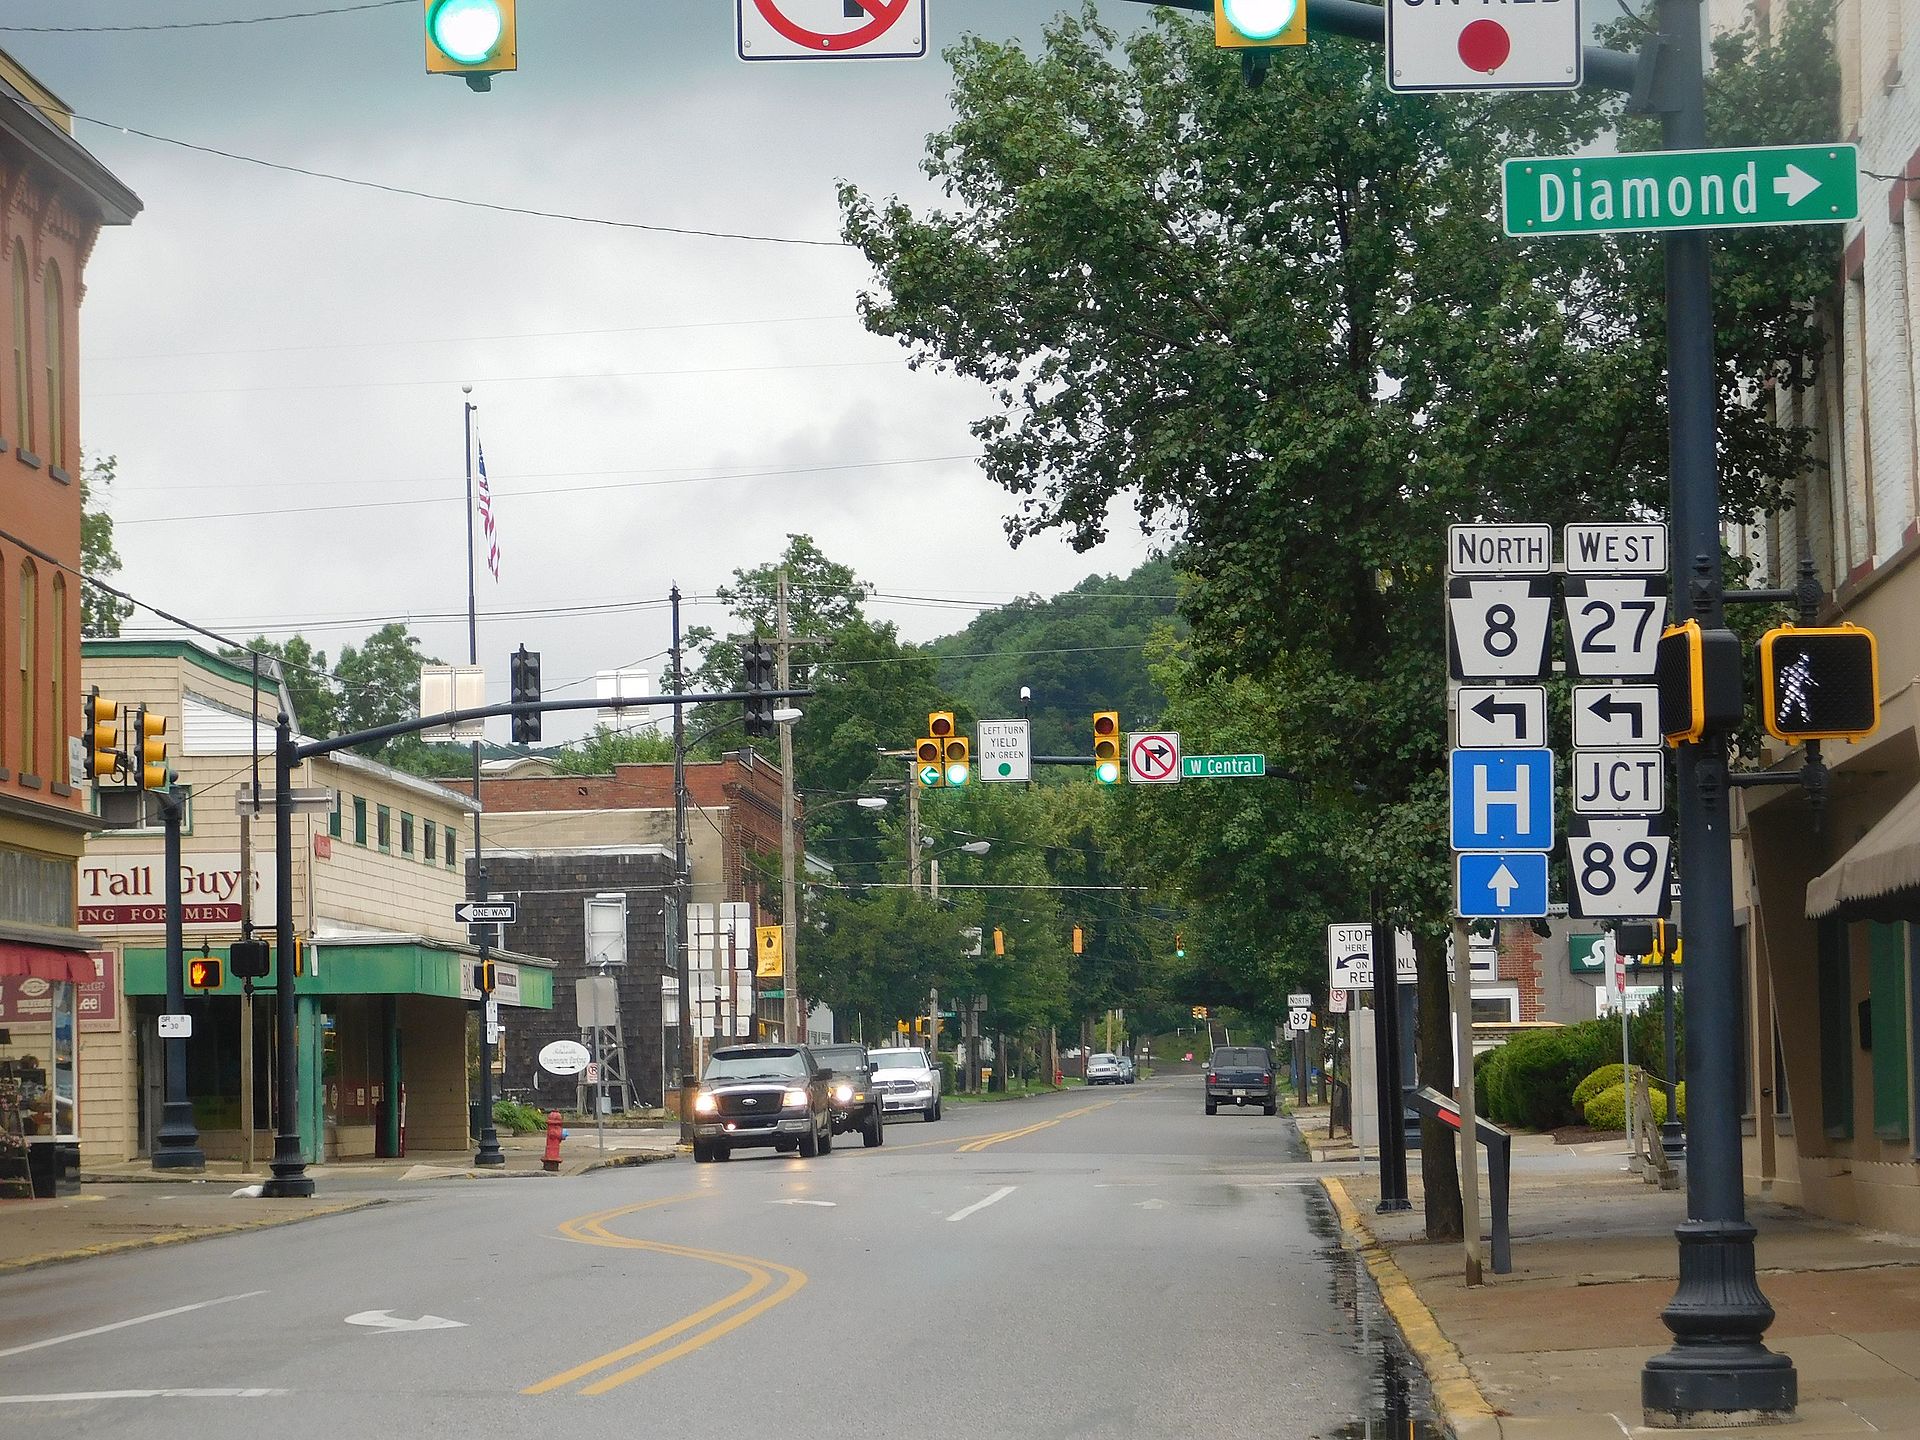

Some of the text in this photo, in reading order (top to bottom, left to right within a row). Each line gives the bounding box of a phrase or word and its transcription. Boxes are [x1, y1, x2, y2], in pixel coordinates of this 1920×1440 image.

[1539, 161, 1757, 222] Diamond
[1458, 533, 1543, 564] NORTH
[1578, 531, 1655, 562] WEST
[1483, 603, 1518, 658] 8
[1580, 600, 1656, 653] 27
[983, 725, 1025, 735] LEFT TURN
[990, 737, 1018, 748] YIELD
[984, 750, 1025, 760] ON GREEN
[1190, 757, 1257, 774] W Central
[1580, 761, 1656, 802] JCT
[1473, 764, 1531, 835] H
[1580, 841, 1658, 896] 89
[83, 865, 153, 898] Tall
[130, 908, 167, 921] FOR
[185, 907, 230, 920] MEN
[473, 908, 509, 917] ONE WAY
[1338, 930, 1372, 942] STOP
[1345, 943, 1367, 952] HERE
[1356, 961, 1368, 969] ON
[1350, 971, 1375, 983] RED
[1289, 996, 1311, 1005] NORTH
[1293, 1012, 1308, 1025] 89
